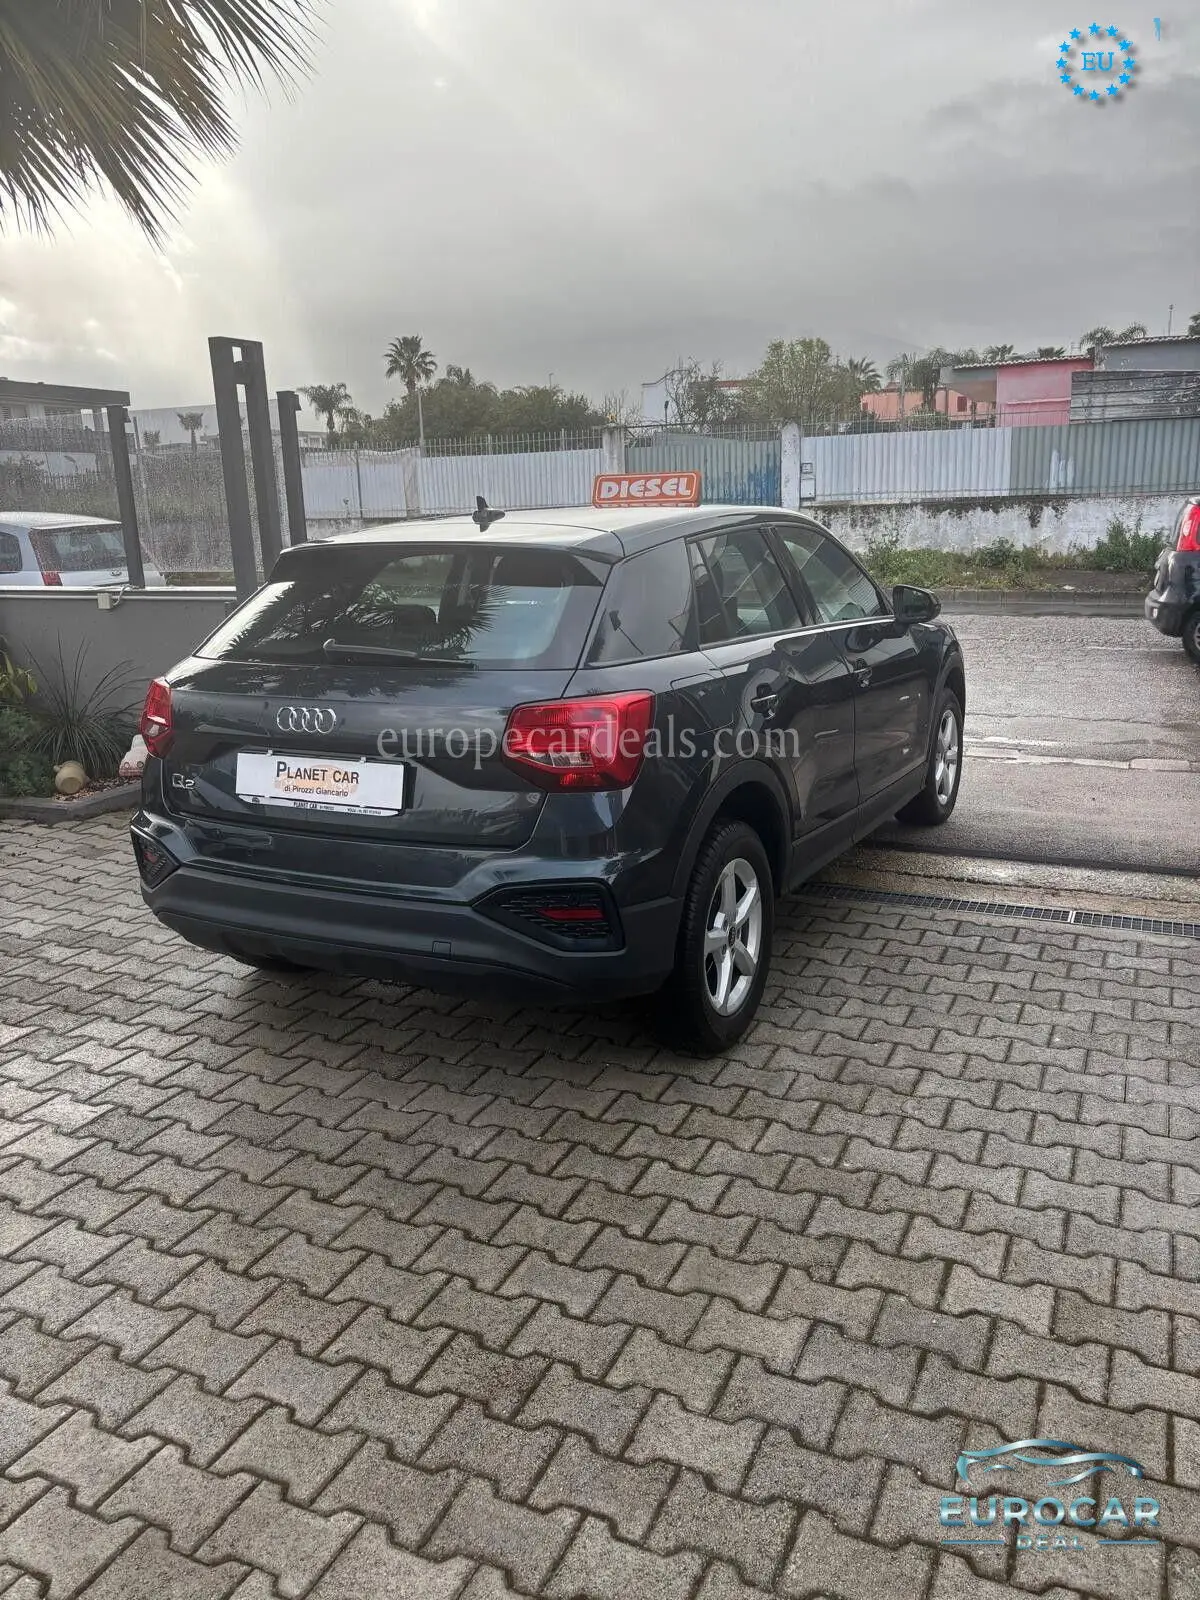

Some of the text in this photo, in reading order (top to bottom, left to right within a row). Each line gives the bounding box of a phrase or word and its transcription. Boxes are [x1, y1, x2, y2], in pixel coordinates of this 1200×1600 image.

[600, 477, 691, 499] DIESEL
[172, 773, 194, 789] Q2
[276, 761, 360, 784] PLANET CAR
[292, 785, 314, 794] Pirozzi
[316, 787, 349, 797] Giancarlo
